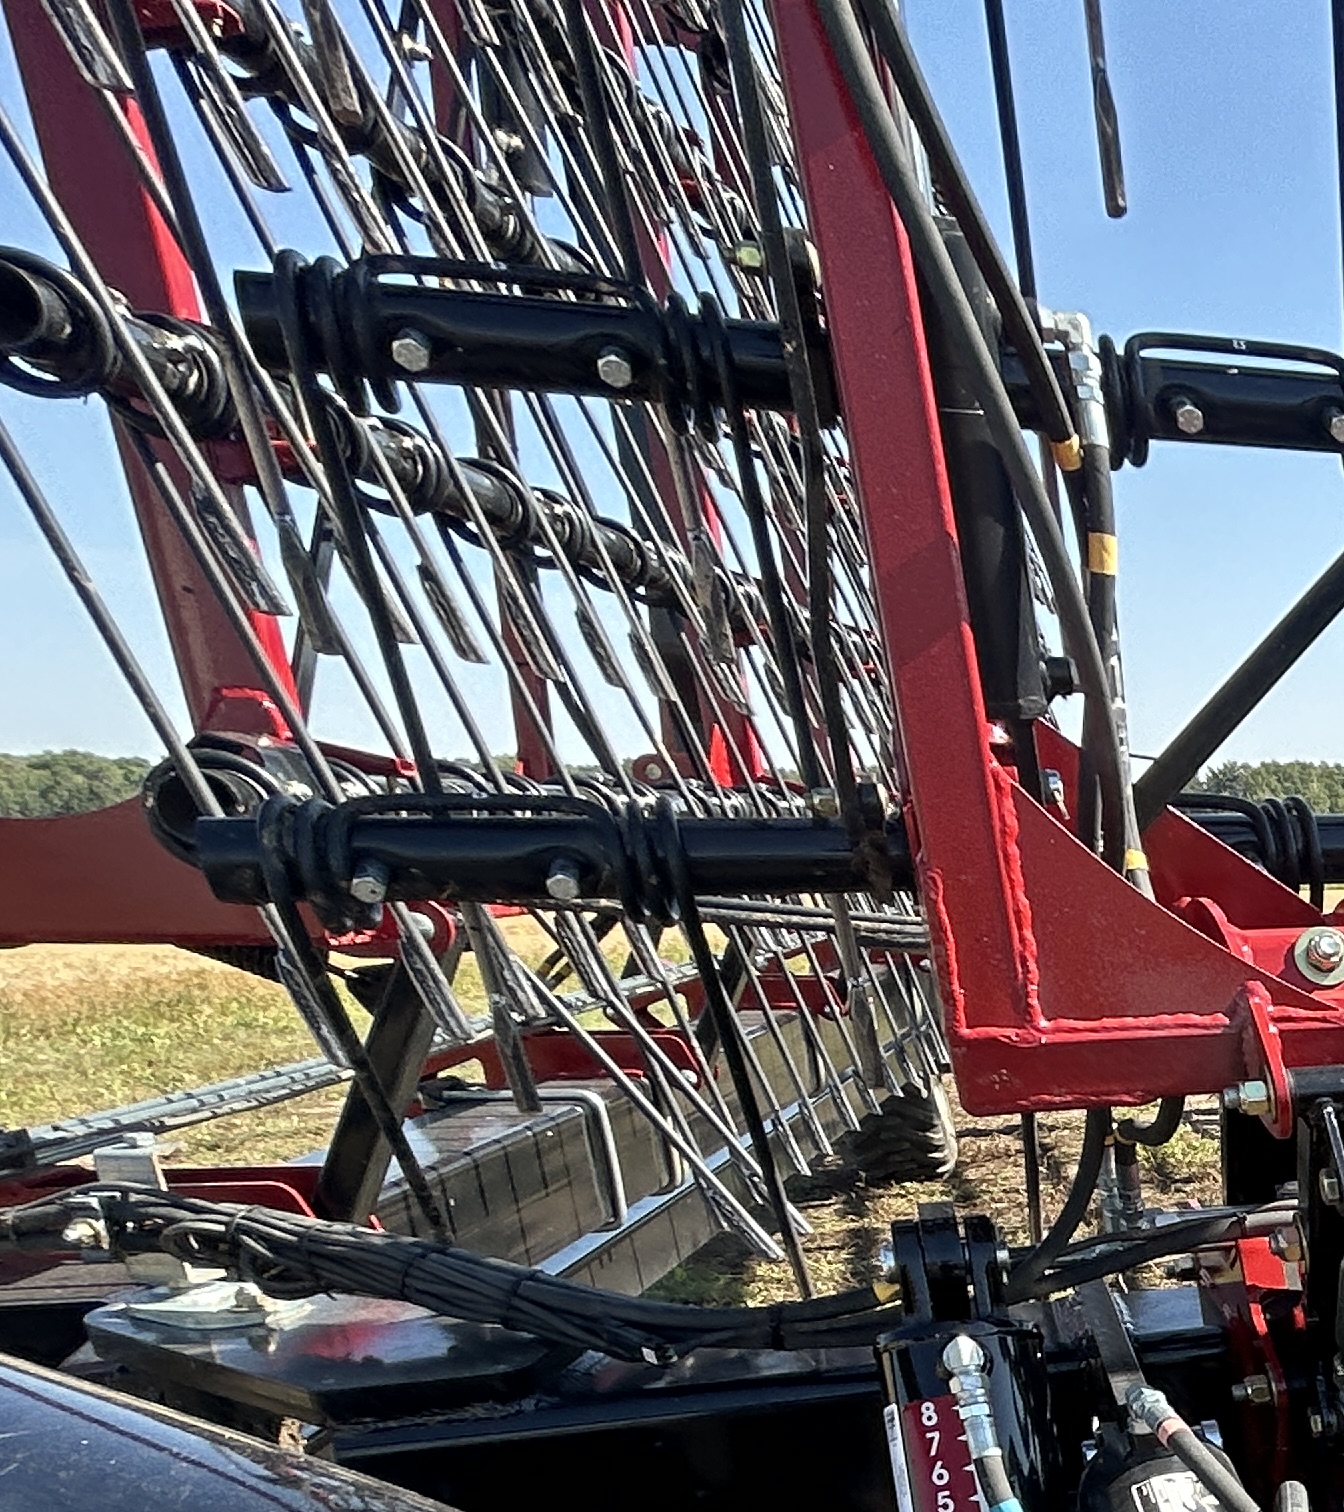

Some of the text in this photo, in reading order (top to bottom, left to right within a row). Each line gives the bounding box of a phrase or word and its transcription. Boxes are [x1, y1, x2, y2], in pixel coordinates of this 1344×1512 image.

[921, 1402, 938, 1426] 8
[925, 1431, 940, 1457] 7
[931, 1460, 949, 1486] 6
